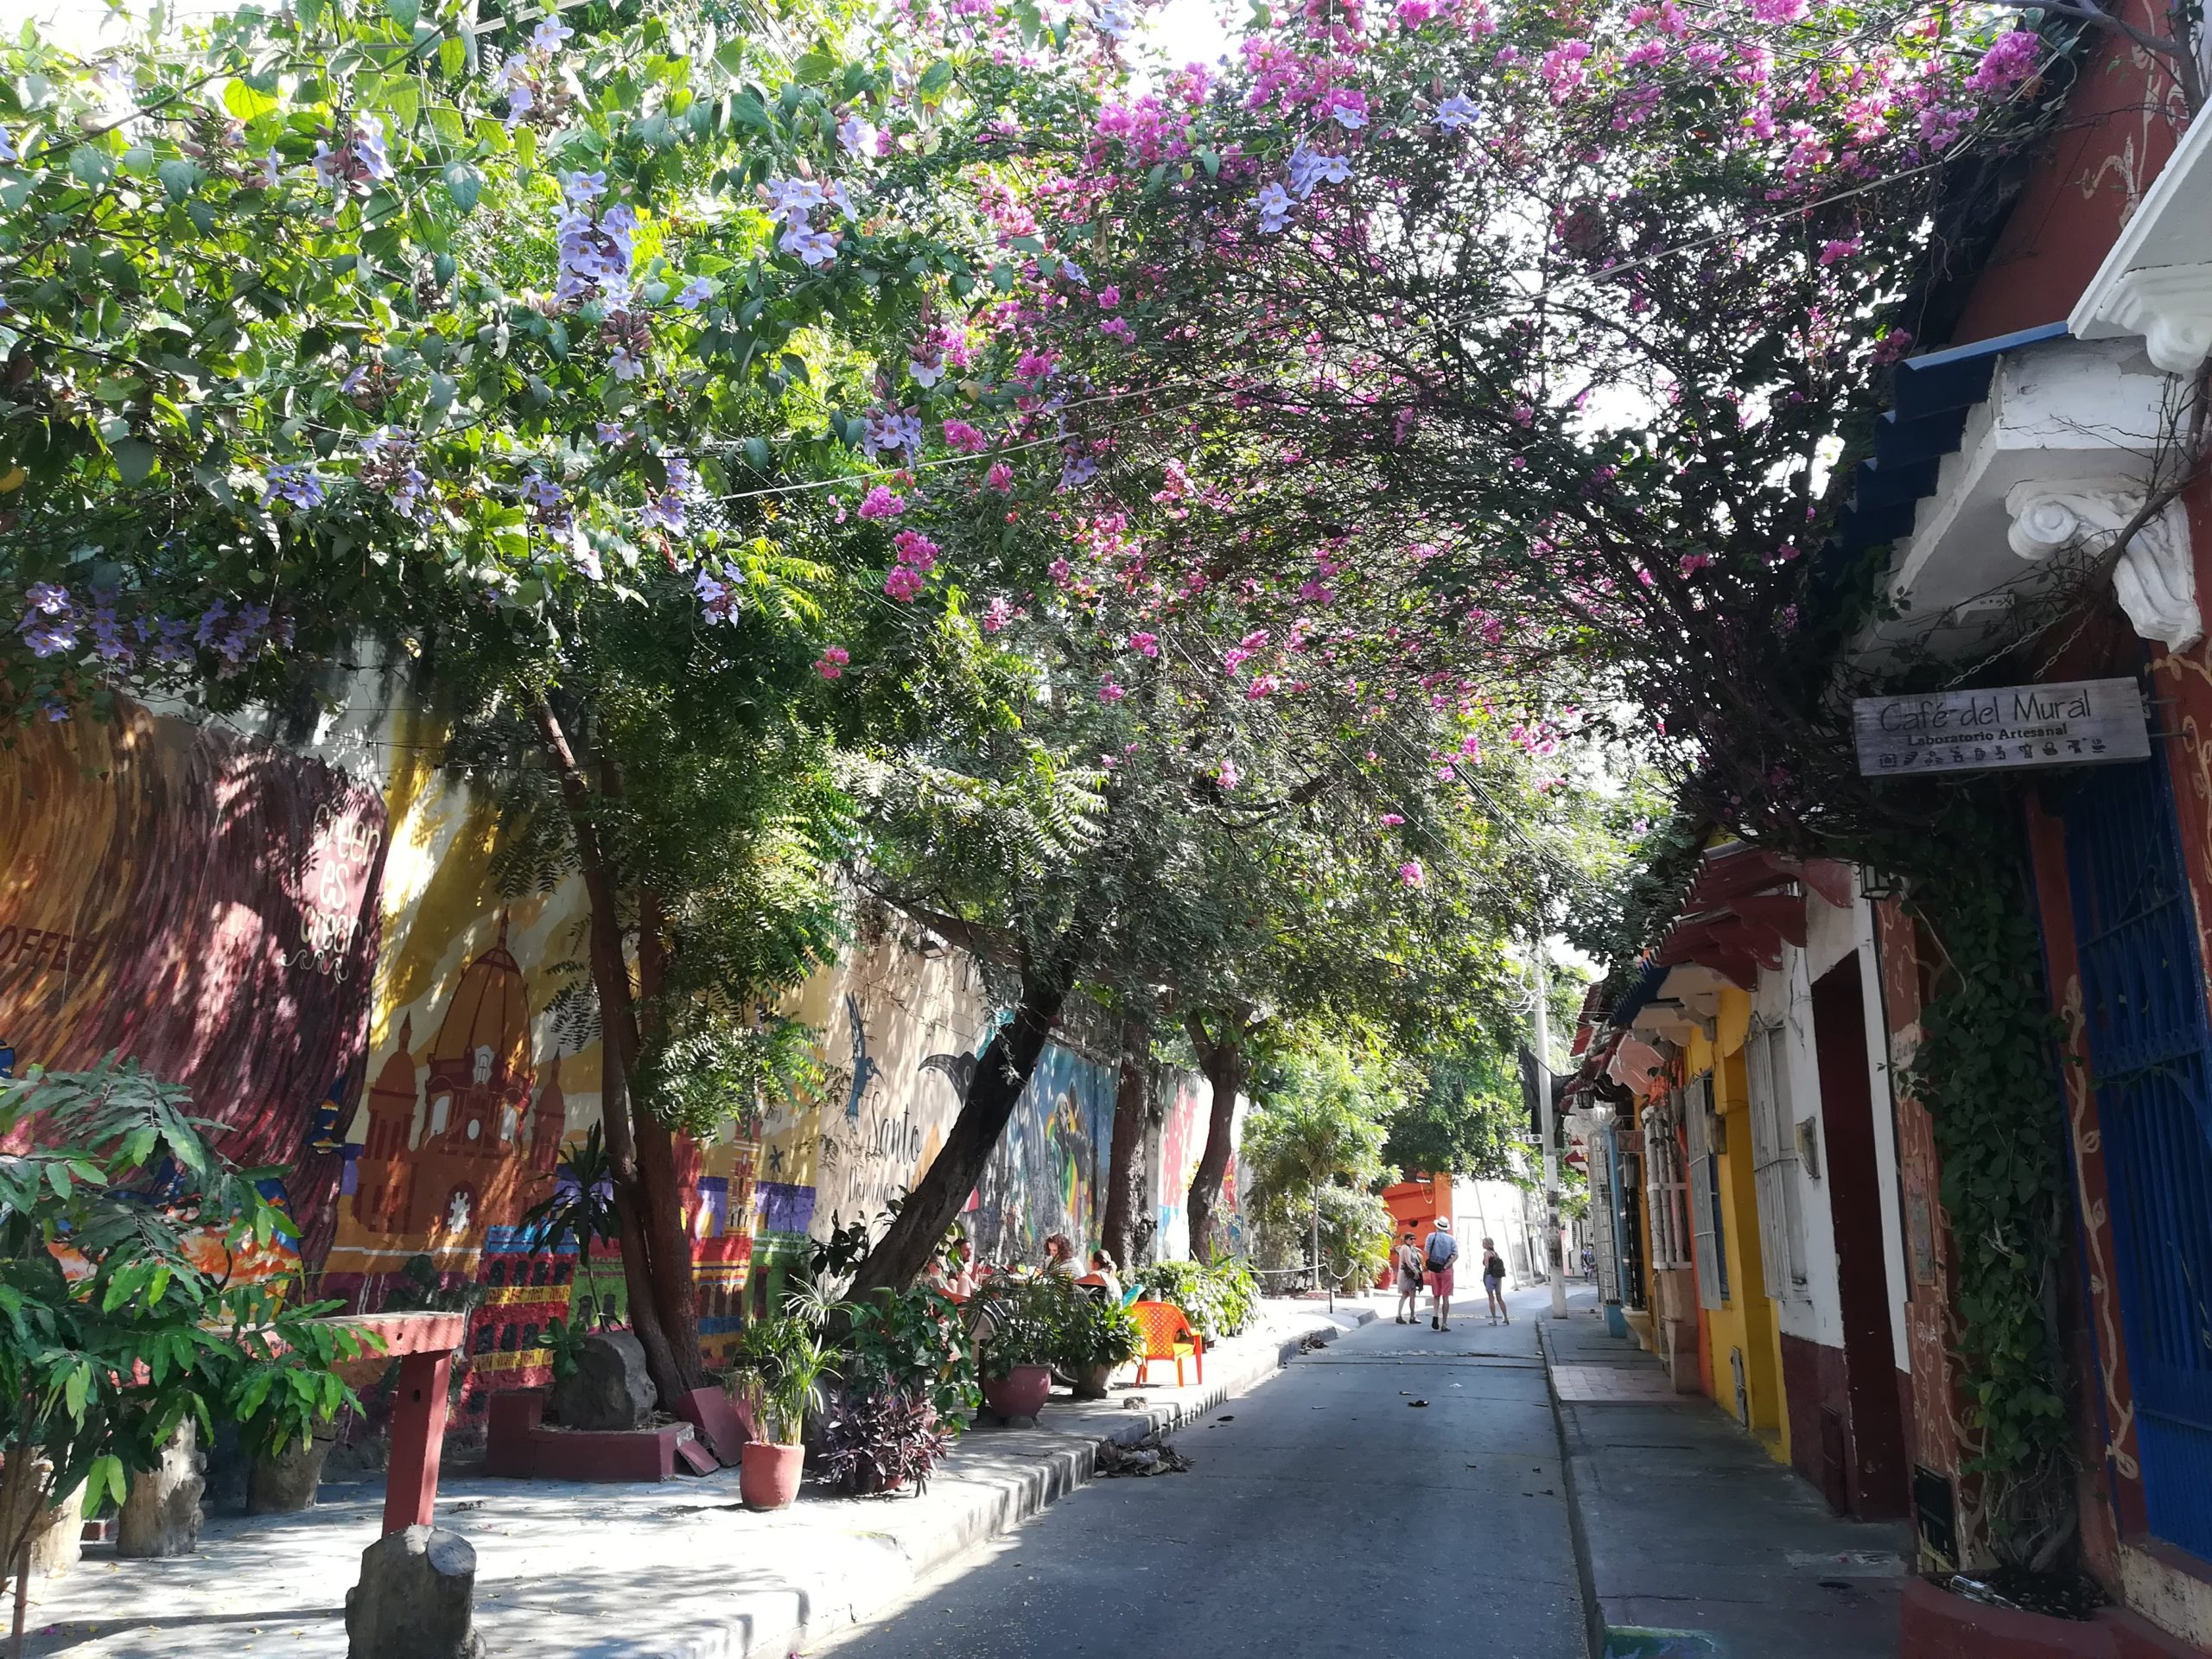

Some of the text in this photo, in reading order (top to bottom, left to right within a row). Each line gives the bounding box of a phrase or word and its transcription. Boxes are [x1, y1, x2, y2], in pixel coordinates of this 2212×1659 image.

[1880, 689, 2091, 733] Café del Mural
[1907, 722, 2068, 747] Laboratorio Artesanal
[868, 1091, 923, 1166] Santo
